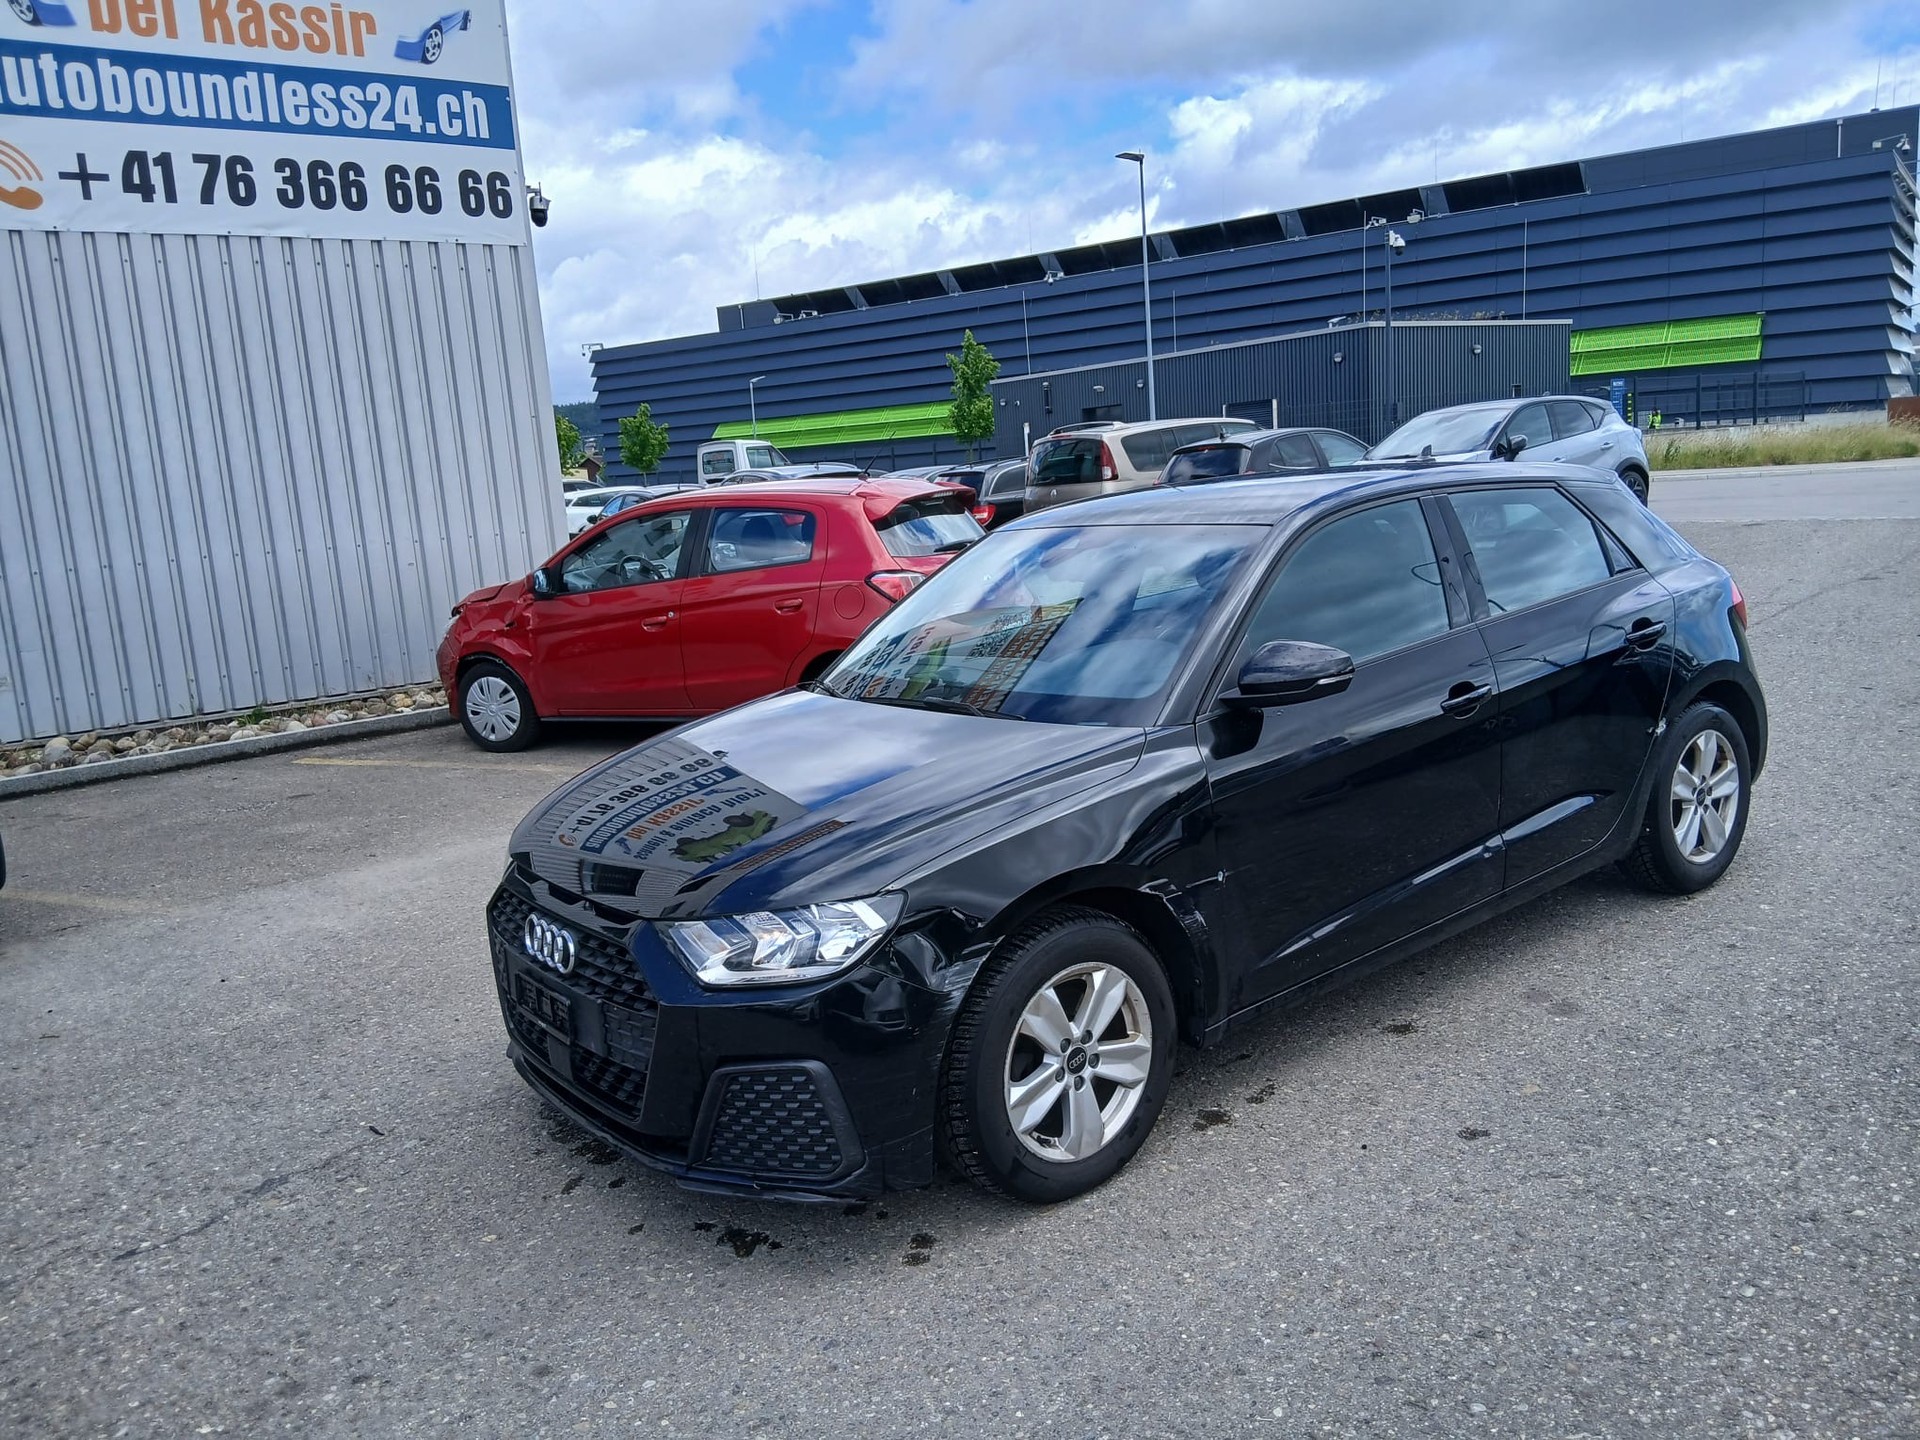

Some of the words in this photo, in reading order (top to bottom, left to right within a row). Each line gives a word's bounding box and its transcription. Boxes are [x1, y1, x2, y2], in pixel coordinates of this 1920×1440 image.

[87, 0, 178, 39] bei
[199, 0, 377, 57] Kassir
[0, 53, 489, 139] utoboundless24.ch
[192, 153, 256, 207] 76
[275, 158, 367, 211] 366
[385, 164, 442, 215] 66
[458, 169, 513, 219] 66
